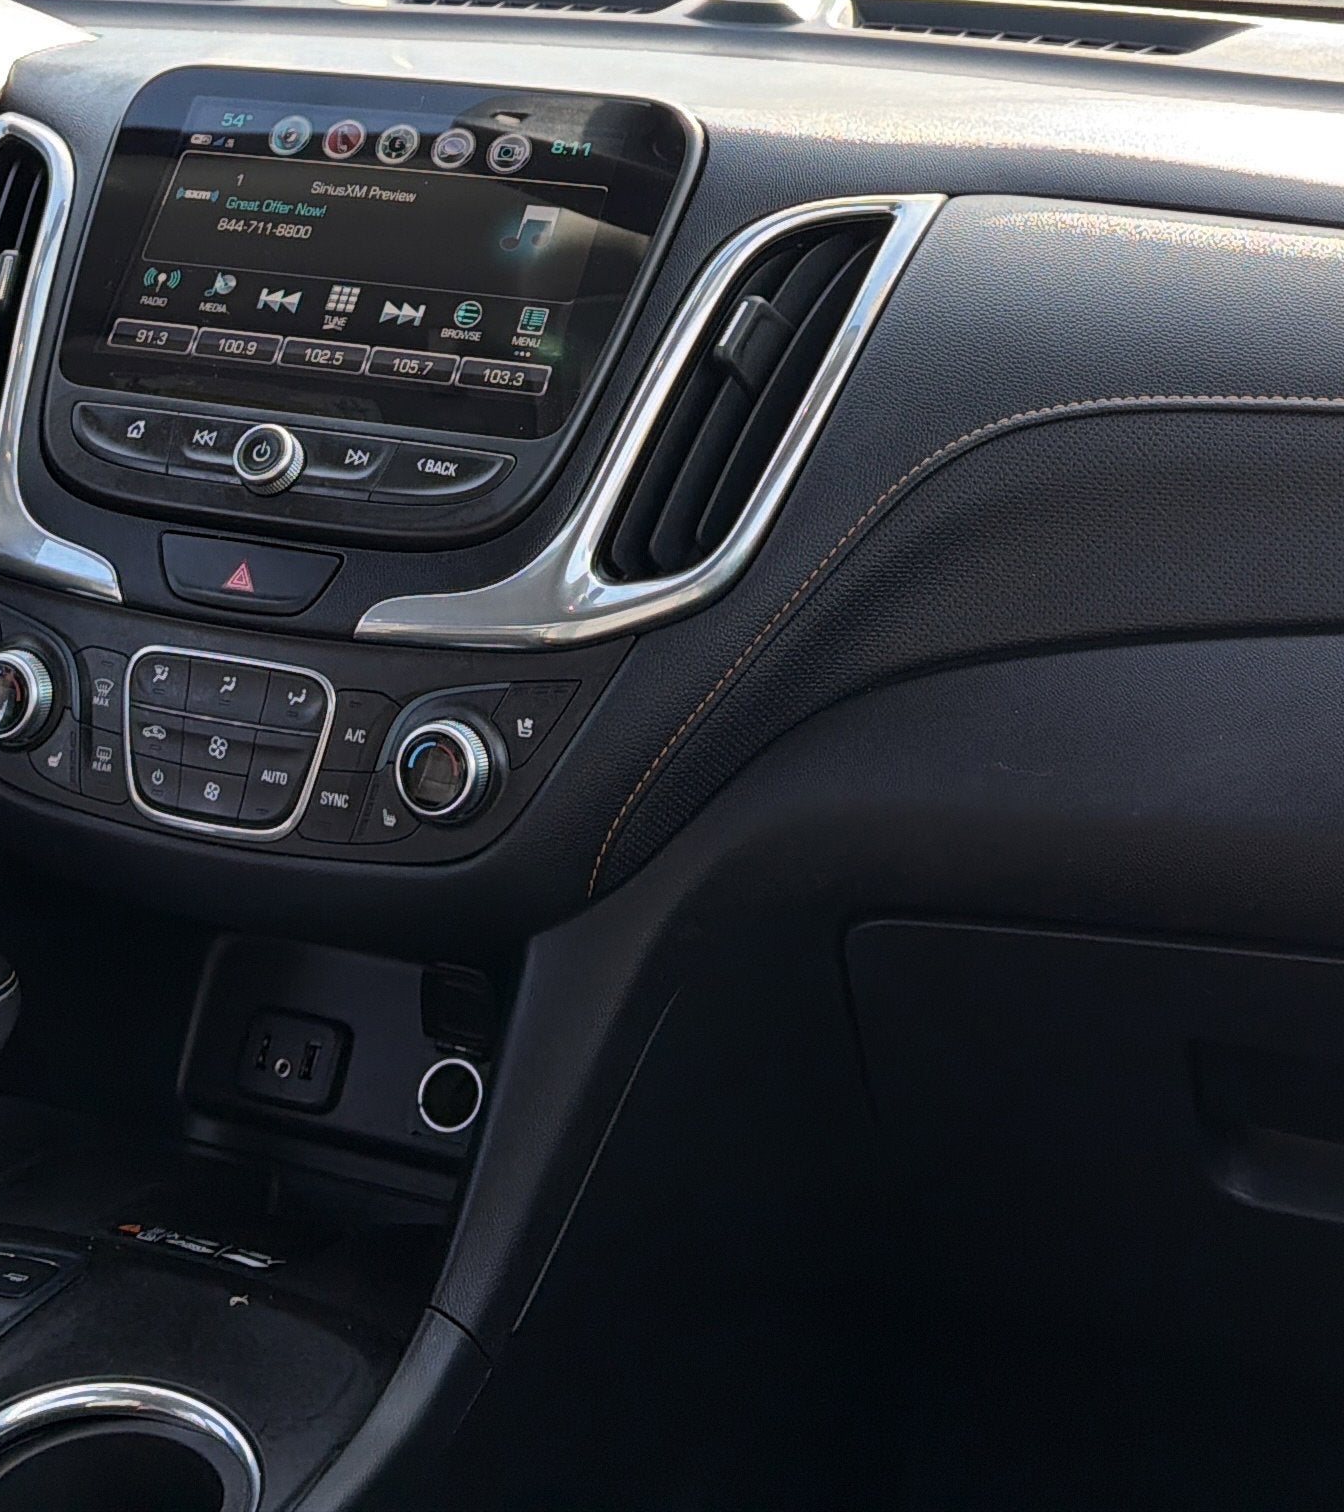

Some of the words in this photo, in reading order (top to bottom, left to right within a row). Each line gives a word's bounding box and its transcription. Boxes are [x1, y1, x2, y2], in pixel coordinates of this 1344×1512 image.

[551, 139, 592, 156] 8:11
[236, 173, 245, 187] 1
[311, 180, 366, 199] SiriusXM
[368, 186, 418, 204] Preview
[225, 196, 260, 213] Great
[262, 199, 294, 216] Offer
[295, 203, 327, 219] Now!
[140, 295, 168, 308] RADIO
[198, 301, 227, 314] MEDIA
[324, 314, 349, 327] TUNE
[135, 329, 169, 346] 91.3
[440, 328, 483, 342] BROWSE
[511, 336, 541, 349] MENU
[218, 338, 258, 356] 100.9
[304, 348, 345, 366] 102.5
[392, 358, 434, 376] 105.7
[482, 368, 526, 387] 103.3
[425, 459, 459, 478] BACK
[92, 695, 110, 708] MAX
[344, 727, 367, 744] A/C
[92, 759, 113, 774] REAR
[261, 768, 289, 786] AUTO
[319, 790, 350, 809] SYNC
